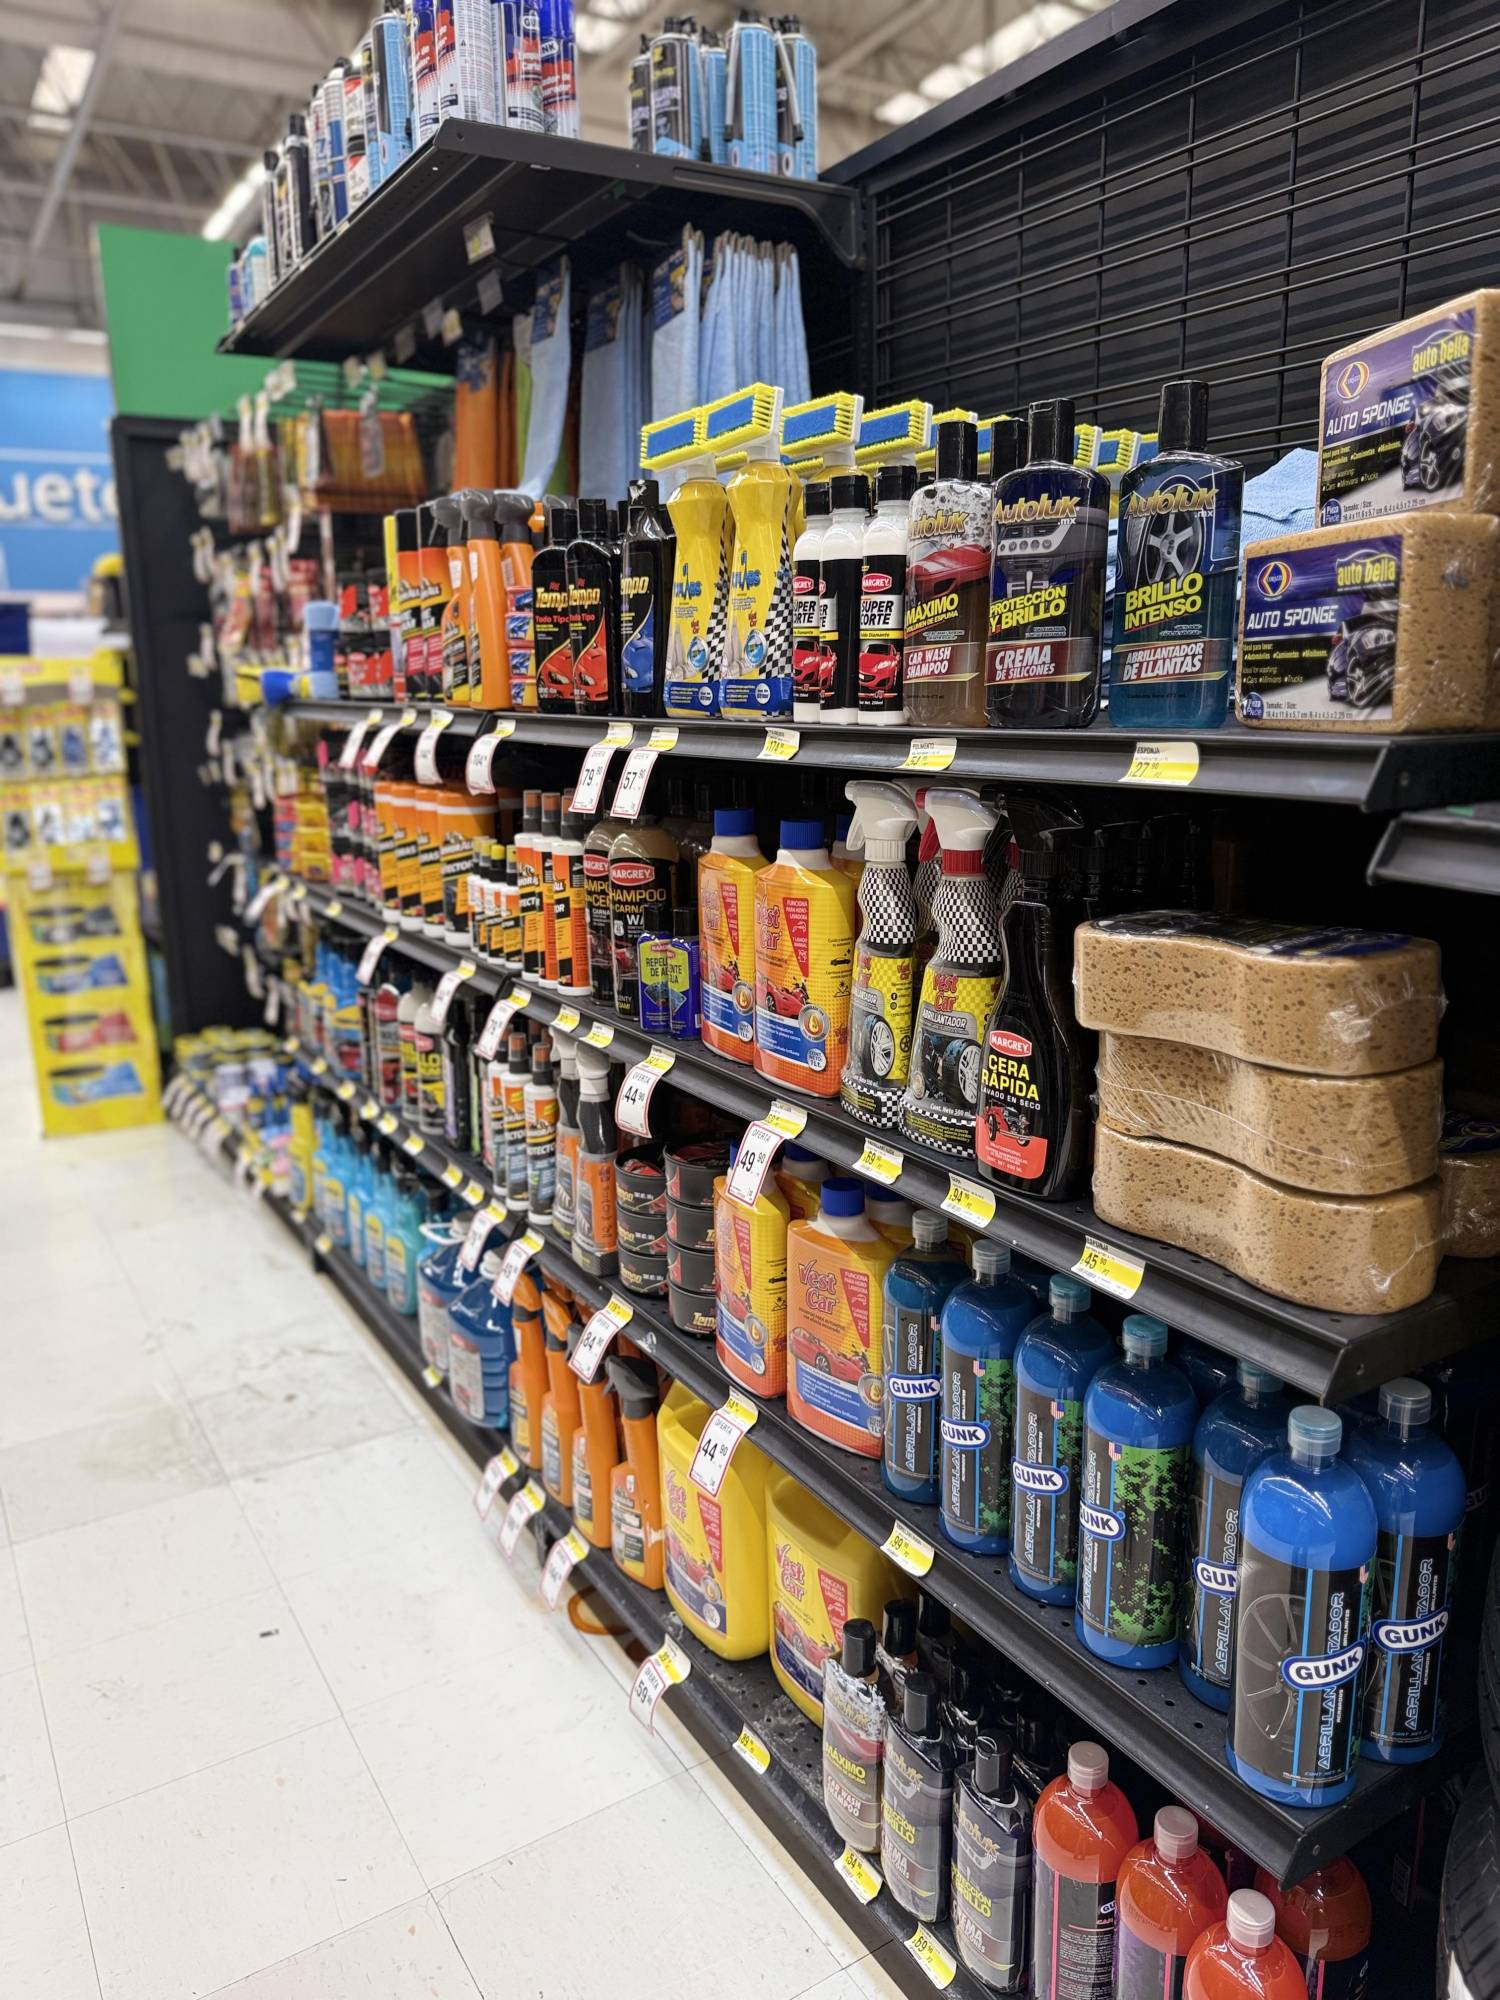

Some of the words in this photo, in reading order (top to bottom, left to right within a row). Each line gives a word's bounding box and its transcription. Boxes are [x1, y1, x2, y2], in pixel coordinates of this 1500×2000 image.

[524, 17, 538, 27] GU
[542, 42, 556, 53] NK
[1412, 352, 1437, 373] auto
[1439, 334, 1470, 362] bella
[1326, 411, 1359, 437] AUTO
[1361, 392, 1414, 426] SPONGE
[993, 493, 1081, 524] Autolux
[1124, 484, 1218, 520] Autolux
[1337, 564, 1362, 586] auto
[1364, 558, 1396, 584] bella
[568, 586, 601, 606] Tempo
[990, 585, 1068, 615] PROTECCIÓN
[1125, 571, 1204, 612] BRILLO
[861, 600, 894, 614] SUPER
[906, 593, 959, 626] MÁXIMO
[990, 615, 1001, 634] Y
[1001, 600, 1066, 630] BRILLO
[1124, 594, 1202, 630] INTENSO
[1247, 611, 1280, 630] AUTO
[1284, 605, 1339, 626] SPONGE
[908, 651, 922, 666] CAR
[924, 646, 952, 662] WASH
[995, 644, 1052, 670] CREMA
[1126, 642, 1204, 664] ABRILLANTADOR
[907, 660, 949, 679] SHAMPOO
[996, 668, 1008, 682] DE
[1008, 663, 1056, 680] SILICONES
[1122, 663, 1138, 681] DE
[1140, 655, 1204, 679] LLANTAS
[1136, 746, 1160, 754] ESPONJA
[582, 768, 595, 786] 79
[623, 772, 638, 790] 57
[1133, 762, 1150, 778] 27
[626, 914, 644, 926] WA
[760, 925, 782, 950] Car
[934, 994, 958, 1012] Car
[990, 1035, 1028, 1054] MARGREY
[988, 1054, 1030, 1081] CERA
[624, 1085, 638, 1104] 44
[981, 1069, 1040, 1102] RÁPIDA
[1007, 1094, 1018, 1104] EN
[1018, 1098, 1041, 1111] SECO
[752, 1128, 772, 1143] OFERTA
[740, 1150, 756, 1172] 49
[756, 1152, 766, 1164] 90
[865, 1150, 876, 1165] 69
[952, 1188, 963, 1204] 94
[1084, 1252, 1098, 1270] 45
[798, 1259, 836, 1295] Vest
[806, 1287, 836, 1315] Car
[582, 1330, 596, 1352] 84
[908, 1323, 918, 1371] TADOR
[892, 1380, 937, 1396] GUNK
[952, 1370, 960, 1420] TADOR
[714, 1418, 732, 1435] OFERTA
[942, 1422, 981, 1442] GUNK
[1027, 1412, 1038, 1464] TADOR
[702, 1438, 718, 1462] 44
[720, 1444, 728, 1456] 90
[1014, 1466, 1058, 1486] GUNK
[1086, 1450, 1097, 1502] TADOR
[892, 1536, 904, 1550] 99
[1222, 1508, 1238, 1564] TADOR
[1200, 1566, 1238, 1588] GUN
[1416, 1558, 1432, 1618] TADOR
[1328, 1592, 1344, 1654] TADOR
[1384, 1616, 1446, 1644] GUNK
[1295, 1651, 1360, 1681] GUNK
[636, 1682, 648, 1704] 59
[848, 1853, 857, 1868] 54
[1102, 1902, 1116, 1912] GU
[914, 1936, 928, 1952] 69
